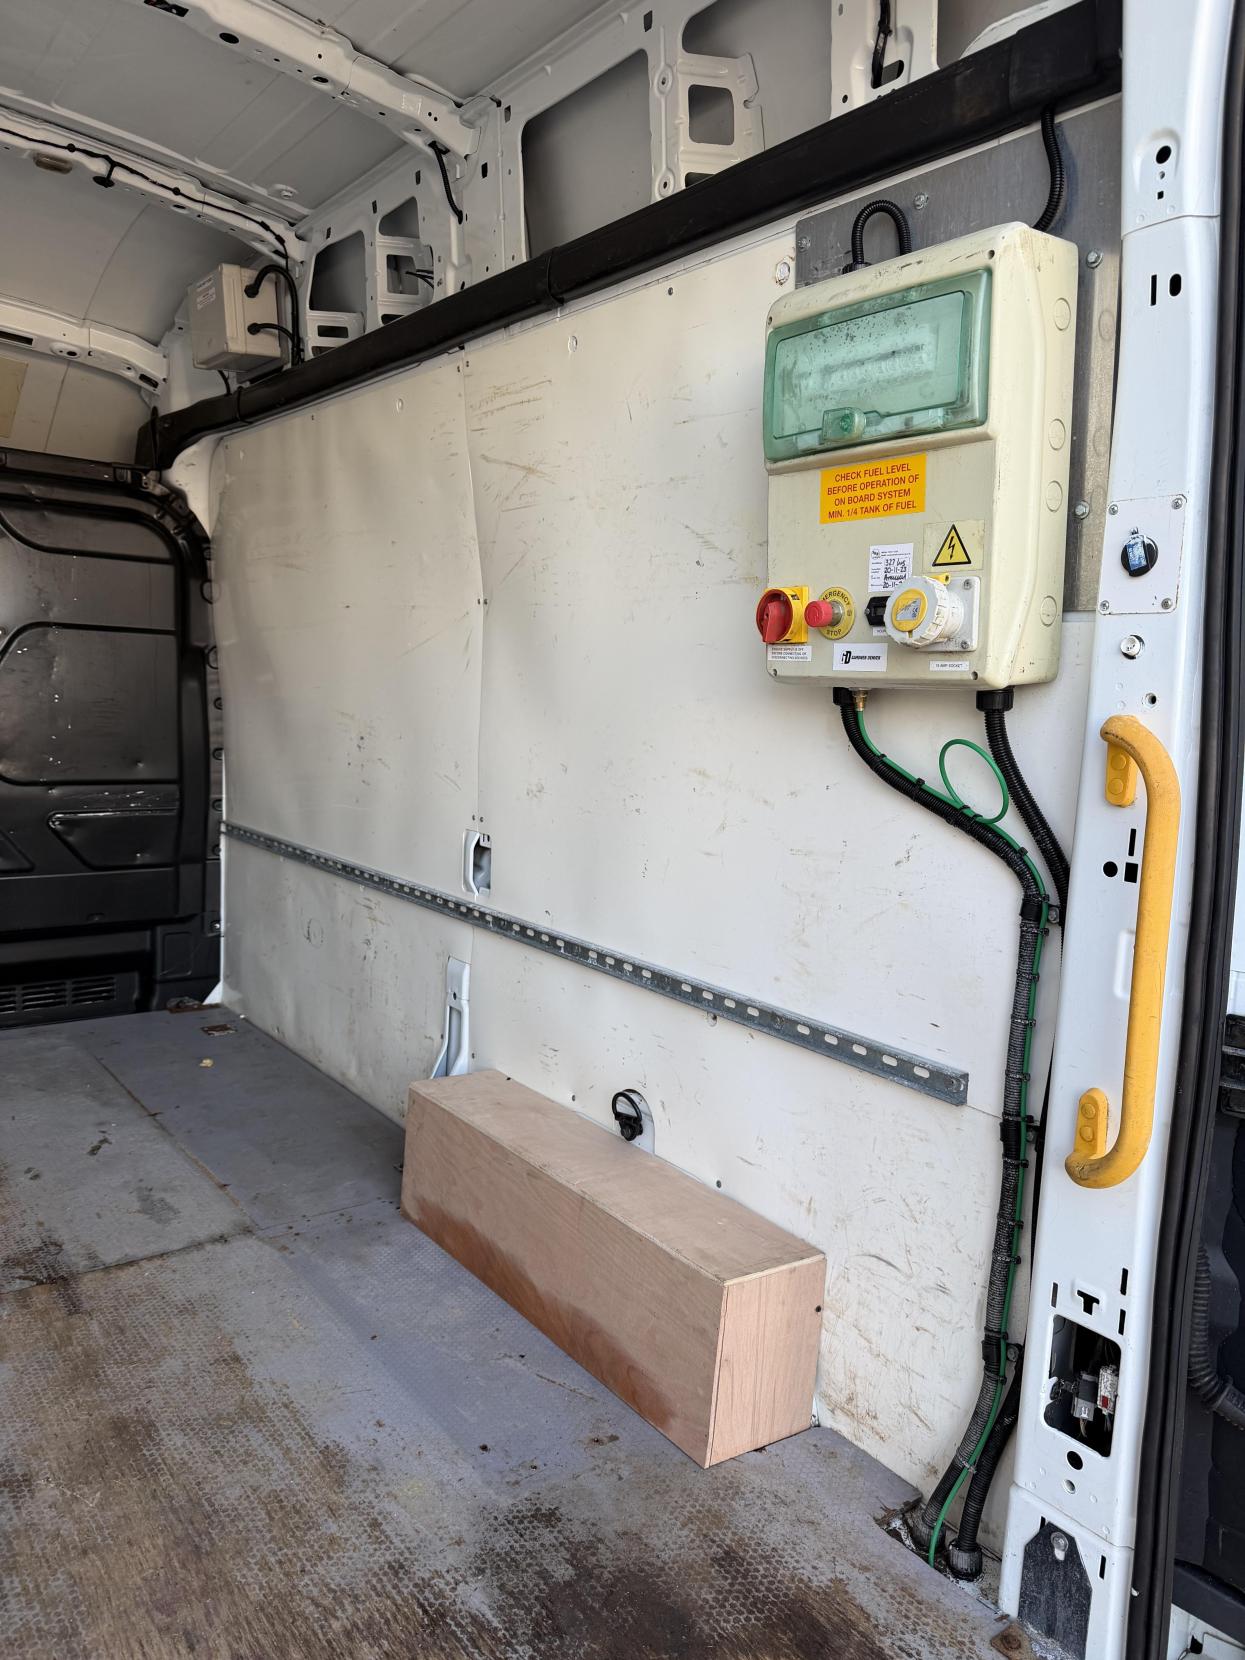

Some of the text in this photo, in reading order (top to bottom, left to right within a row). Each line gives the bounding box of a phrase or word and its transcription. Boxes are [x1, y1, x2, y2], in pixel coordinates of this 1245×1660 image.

[835, 463, 911, 482] CHECK FUEL LEVEL
[828, 474, 919, 495] BEFORE OPERATION OF
[834, 488, 911, 506] ON BOARD SYSTEM
[828, 500, 916, 519] MIN. 1/4 TANK OF FUEL
[883, 580, 903, 588] 20-11-
[826, 628, 841, 636] STOP
